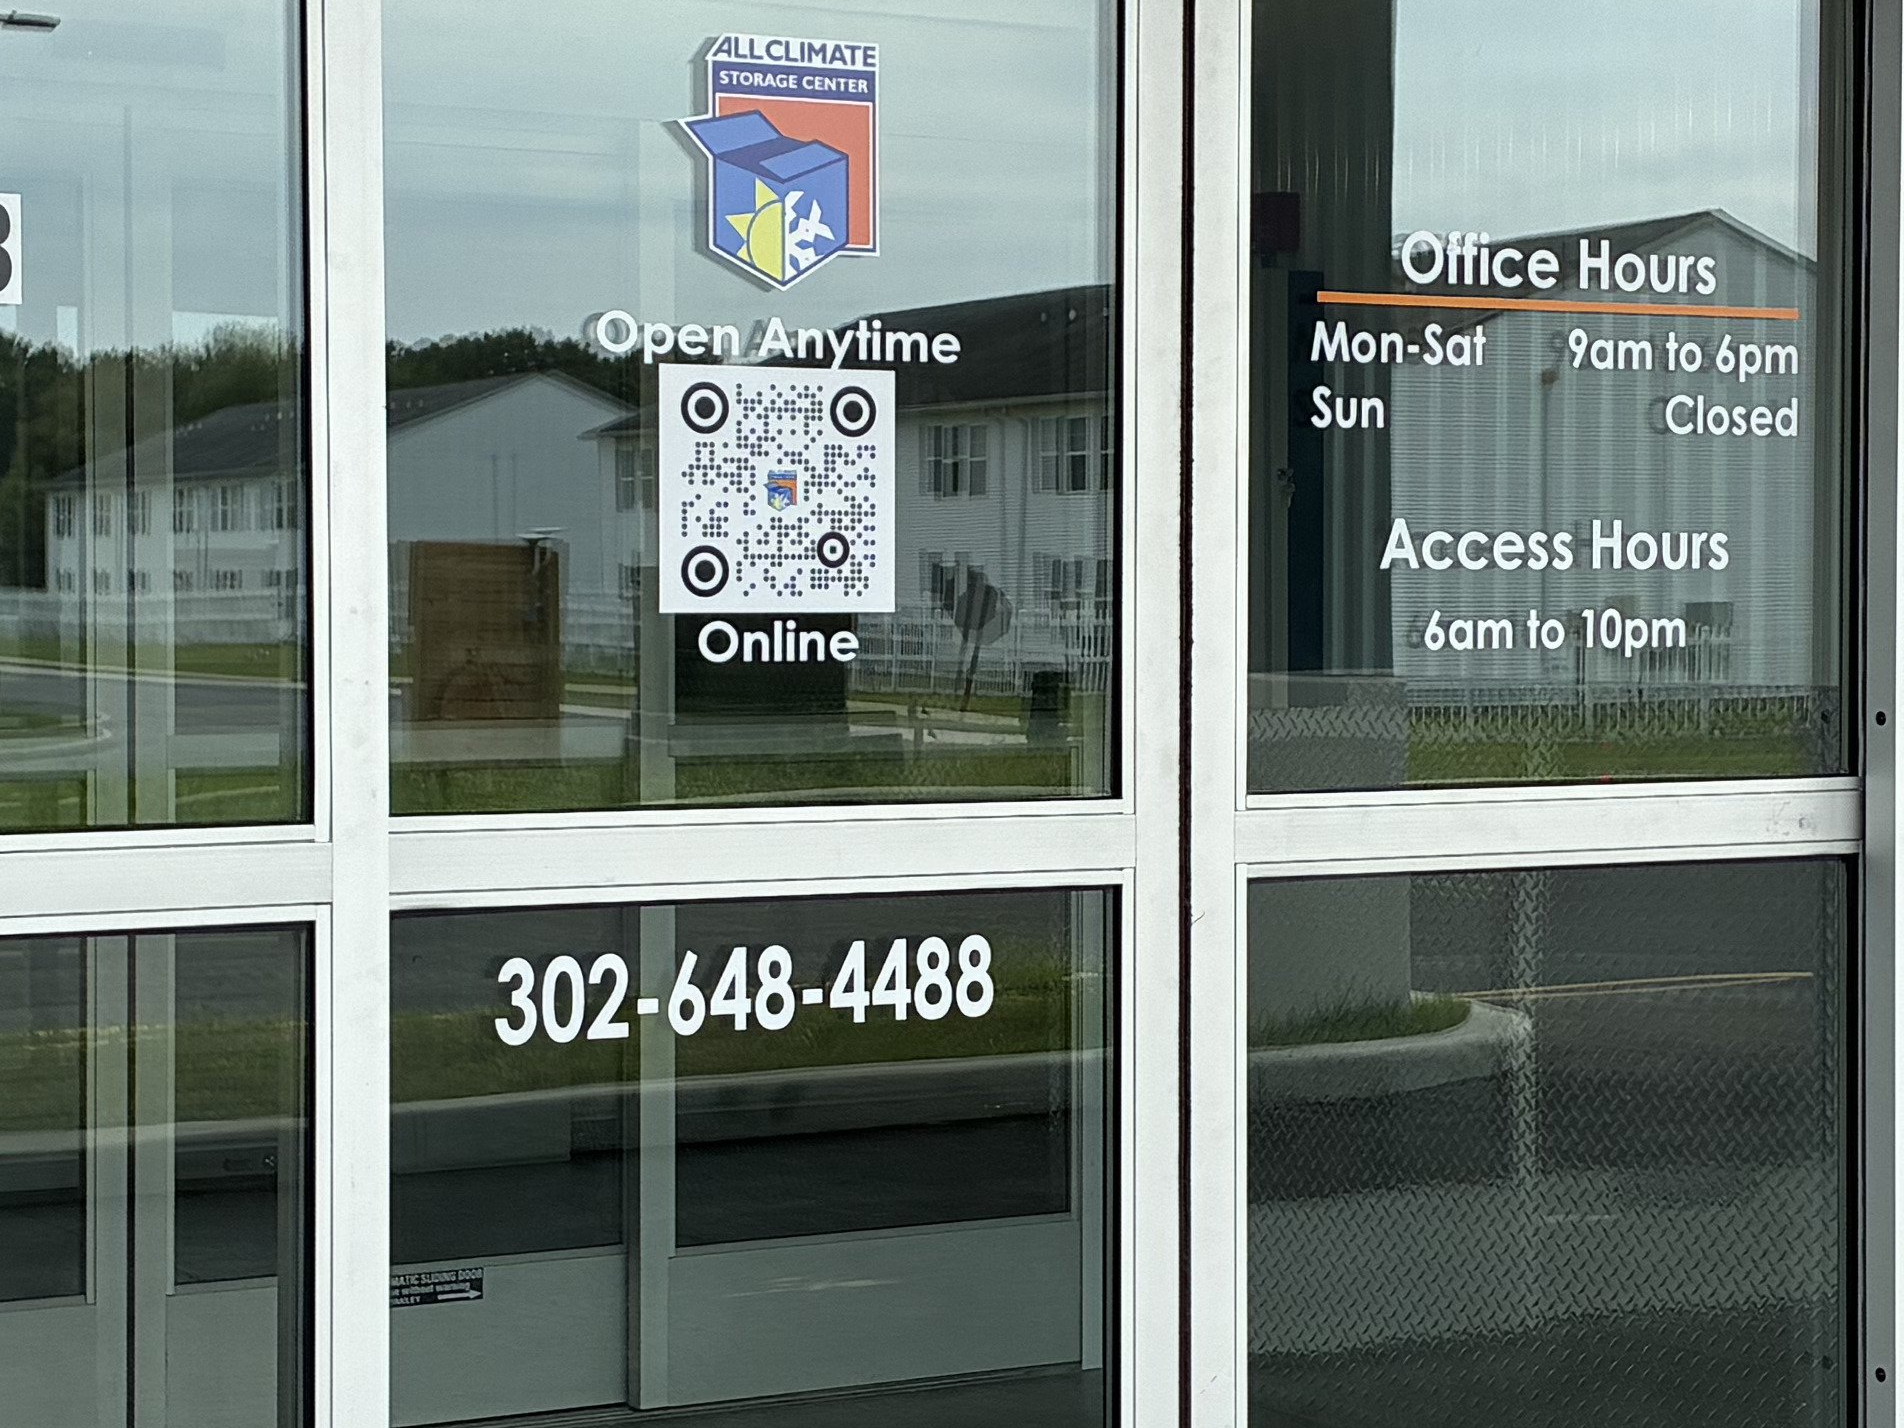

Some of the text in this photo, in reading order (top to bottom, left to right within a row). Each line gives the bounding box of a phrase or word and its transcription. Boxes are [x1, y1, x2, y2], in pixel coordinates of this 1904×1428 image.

[719, 70, 869, 94] STORAGE CENTER
[1401, 231, 1717, 294] Office Hours
[596, 309, 961, 370] Open Anytime
[1310, 320, 1799, 383] Mon-Sat 9am to 6pm
[1310, 384, 1799, 437] Sun Closed
[1379, 517, 1729, 571] Access Hours
[698, 619, 860, 663] Online
[1424, 608, 1687, 658] 6am to 10pm
[495, 934, 994, 1046] 302-648-4488
